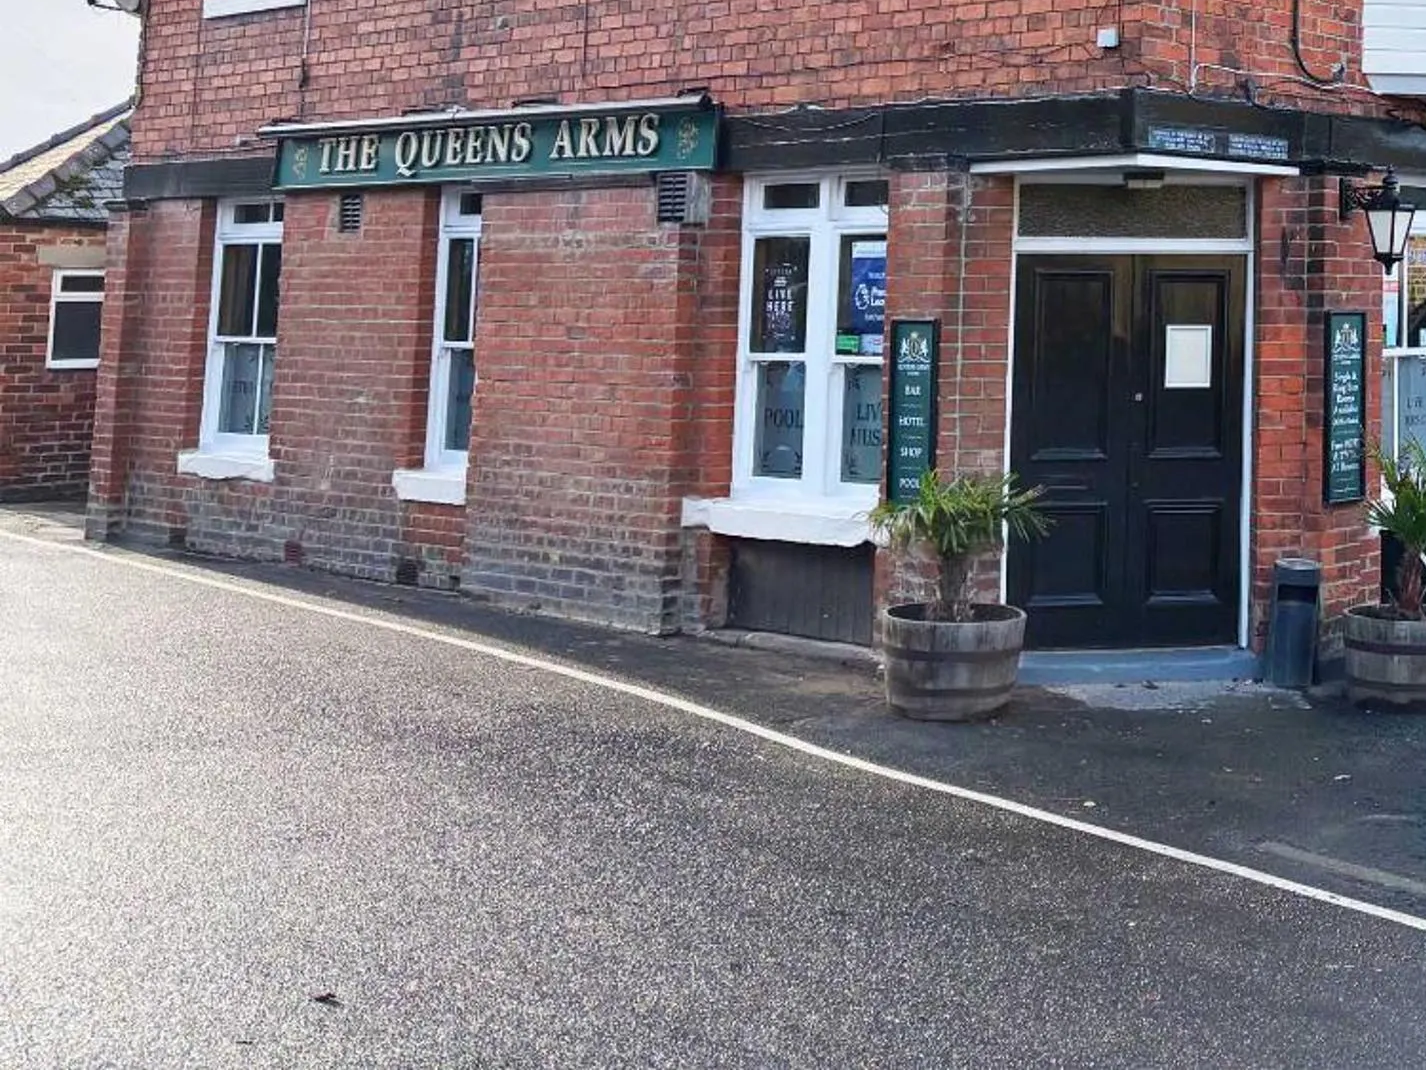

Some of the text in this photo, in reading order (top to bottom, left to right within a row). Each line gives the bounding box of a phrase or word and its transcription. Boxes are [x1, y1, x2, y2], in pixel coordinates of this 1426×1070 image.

[319, 113, 660, 177] THE QUEENS ARMS
[764, 408, 804, 429] POOL
[899, 416, 926, 427] HOTEL
[899, 477, 920, 490] POOL
